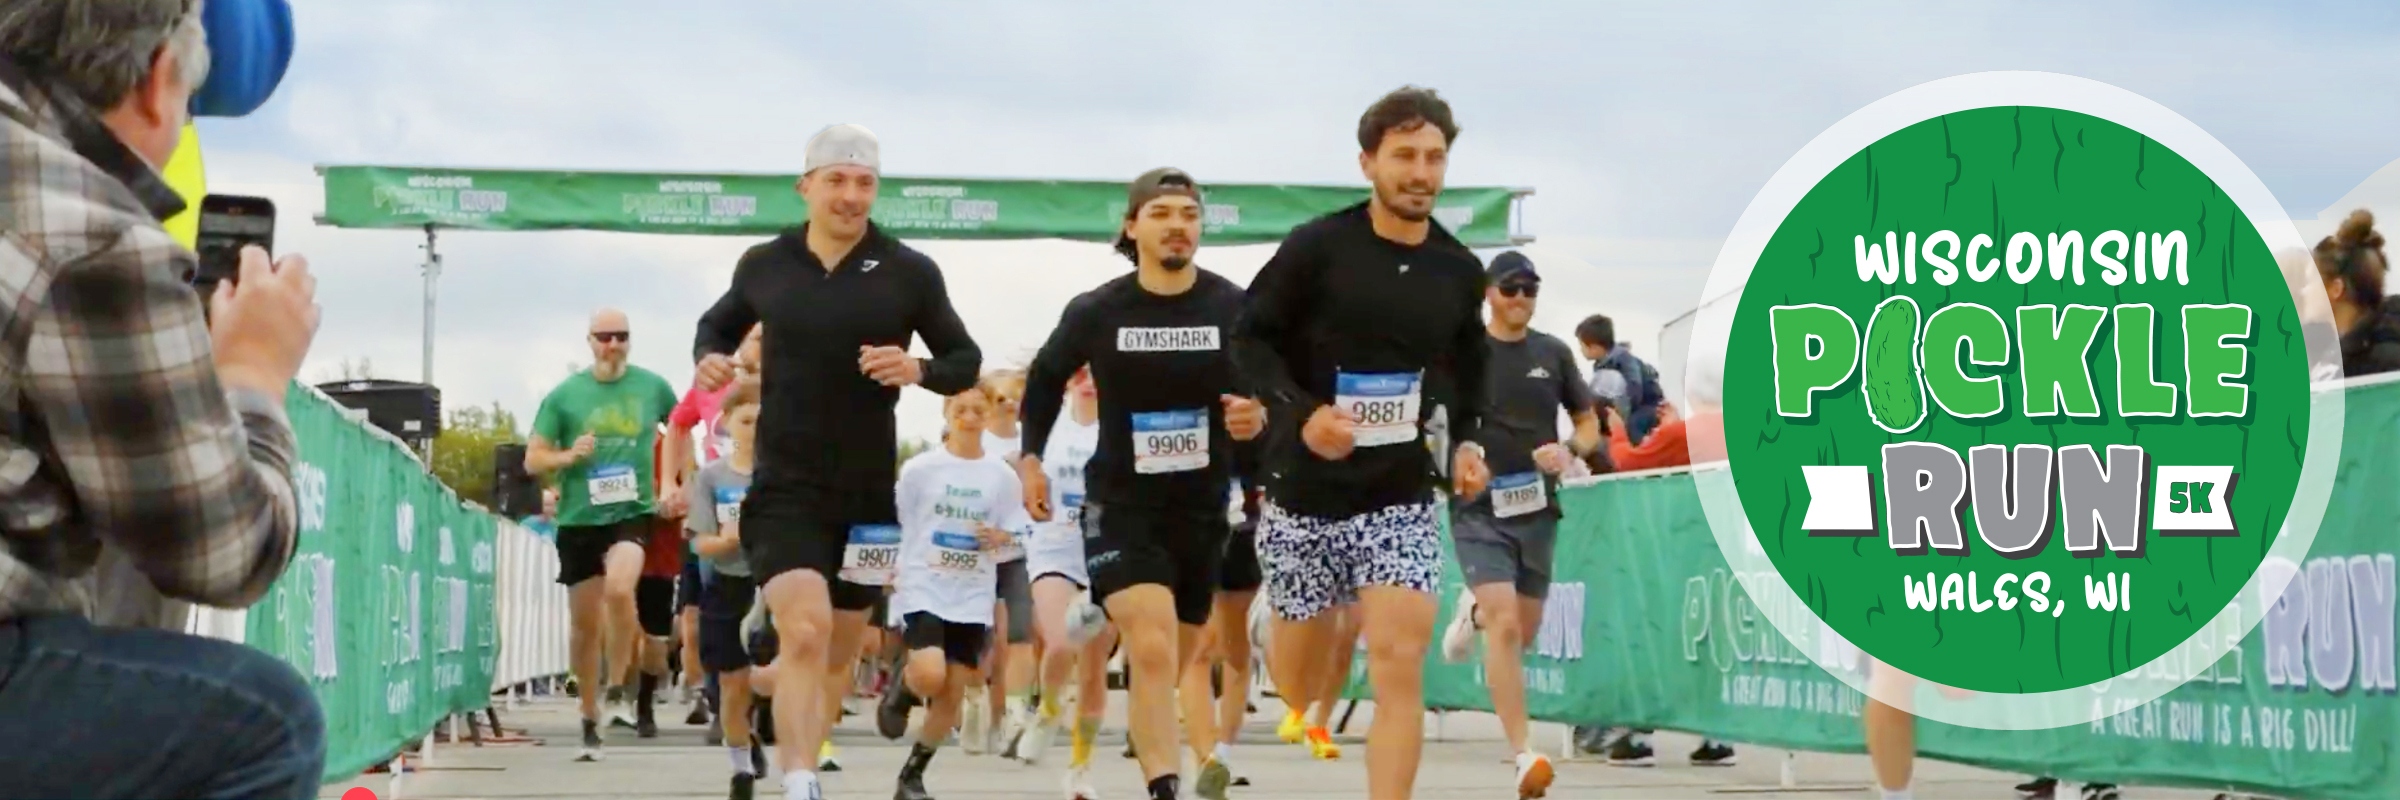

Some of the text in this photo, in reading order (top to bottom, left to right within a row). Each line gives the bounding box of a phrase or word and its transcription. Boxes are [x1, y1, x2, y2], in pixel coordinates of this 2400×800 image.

[1124, 329, 1213, 349] GYMSHARK
[1352, 400, 1404, 424] 9881
[1148, 432, 1198, 456] 9906
[857, 547, 899, 568] 9907
[940, 549, 979, 568] 9995
[2258, 553, 2397, 691] RUN
[2090, 698, 2357, 753] A GREAT RUN IS A BIG DILL!
